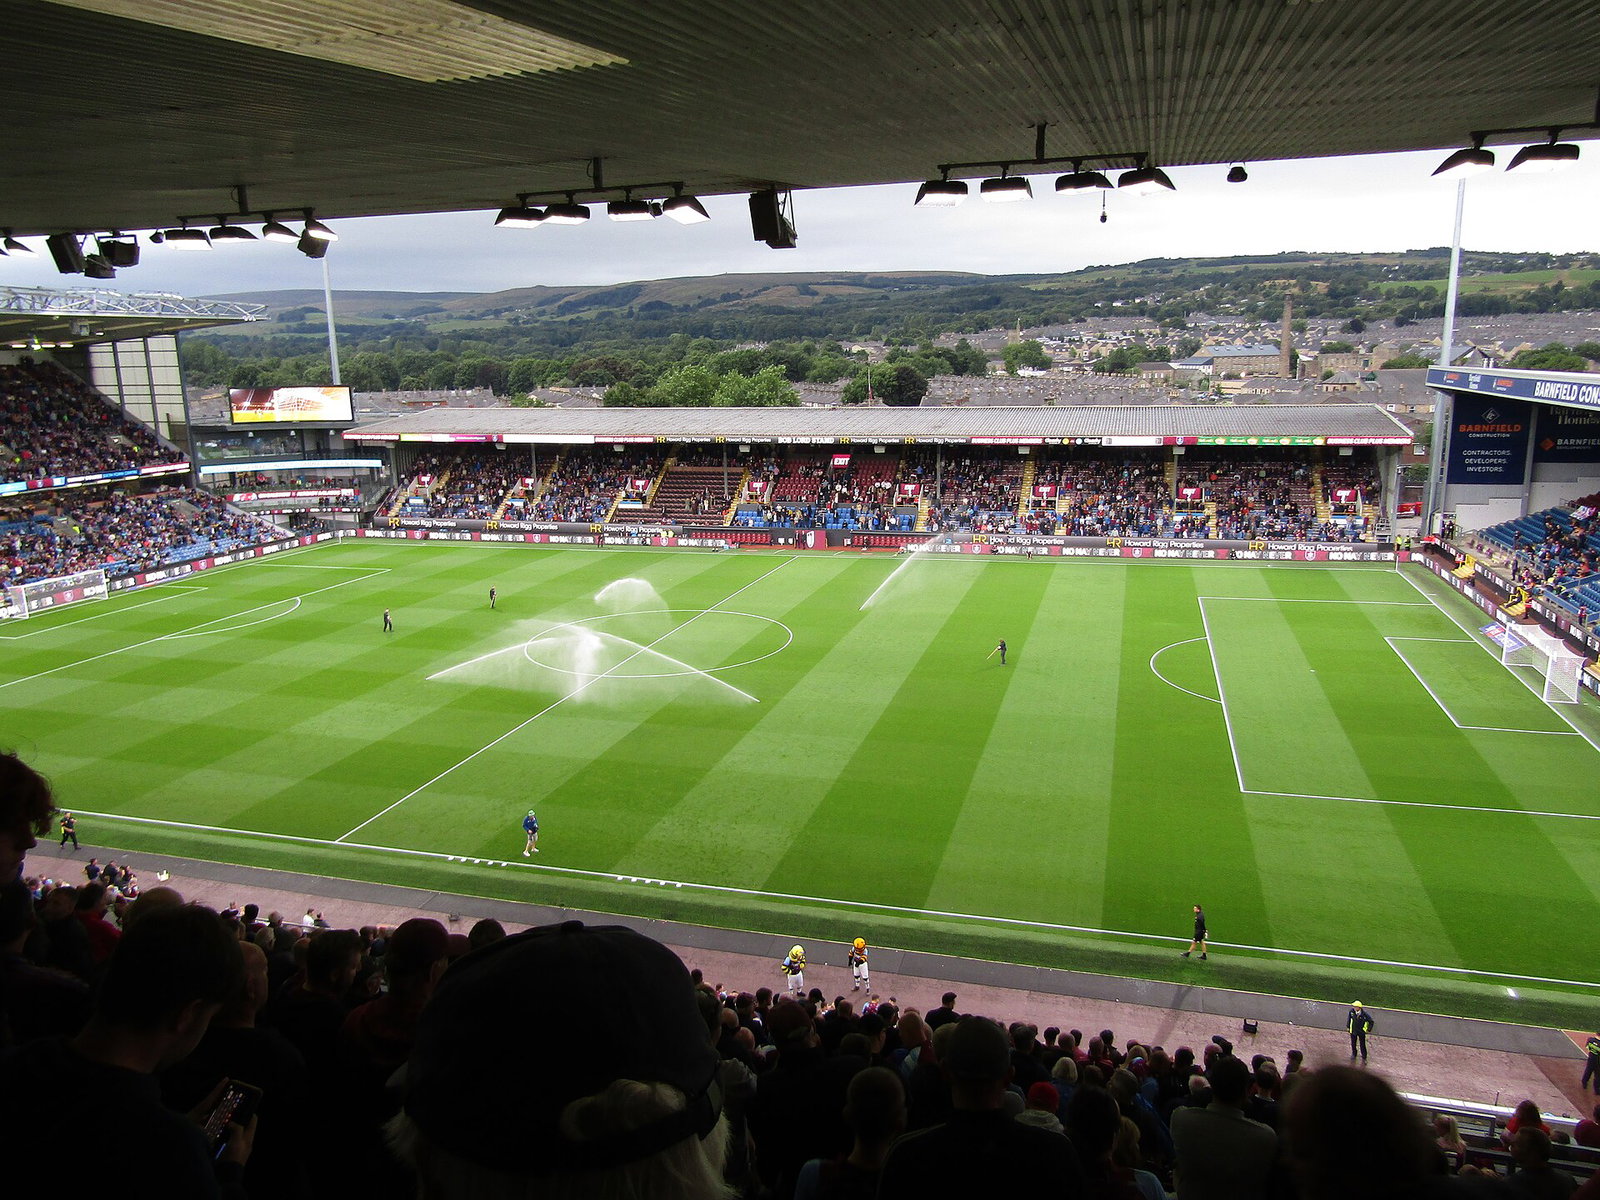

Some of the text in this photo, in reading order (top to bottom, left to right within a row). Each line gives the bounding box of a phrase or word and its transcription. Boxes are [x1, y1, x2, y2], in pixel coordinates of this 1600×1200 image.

[1534, 381, 1578, 401] BARNFIELD
[1459, 424, 1522, 432] BARNFIELD
[834, 457, 850, 465] EXIT
[486, 521, 498, 530] HR
[500, 521, 520, 529] Howard
[590, 523, 602, 533] HR
[973, 534, 987, 544] HR
[1016, 537, 1031, 545] Rigg
[1106, 538, 1121, 547] HR
[1152, 540, 1168, 548] Rigg
[1170, 541, 1204, 549] Properties
[1248, 541, 1264, 550] HR
